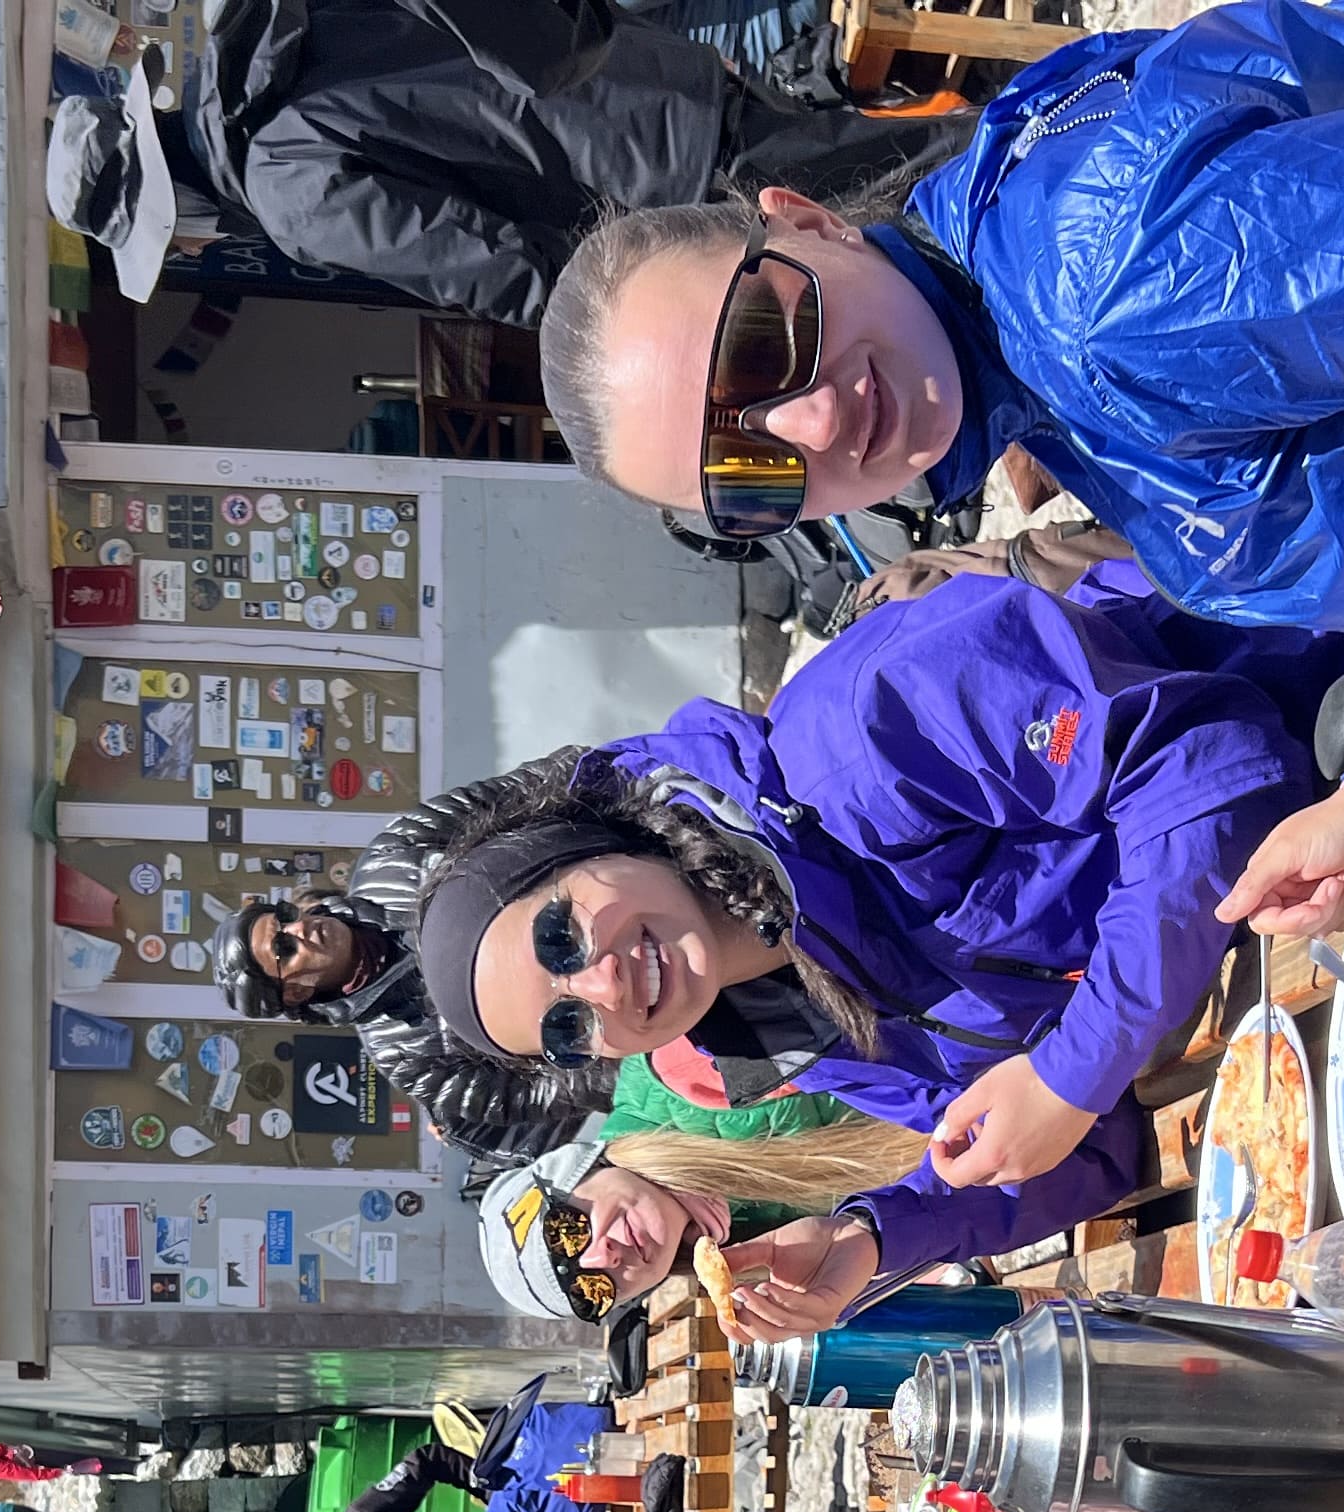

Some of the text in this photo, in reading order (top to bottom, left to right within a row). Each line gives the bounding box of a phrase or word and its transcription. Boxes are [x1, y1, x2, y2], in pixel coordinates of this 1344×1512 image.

[1047, 705, 1071, 763] SUMMIT
[1057, 710, 1082, 766] SERIES
[359, 1086, 367, 1124] ALPINIST
[367, 1061, 377, 1124] EXPEDITIO
[268, 1212, 277, 1246] VIRGIN
[276, 1216, 286, 1246] NEPAL
